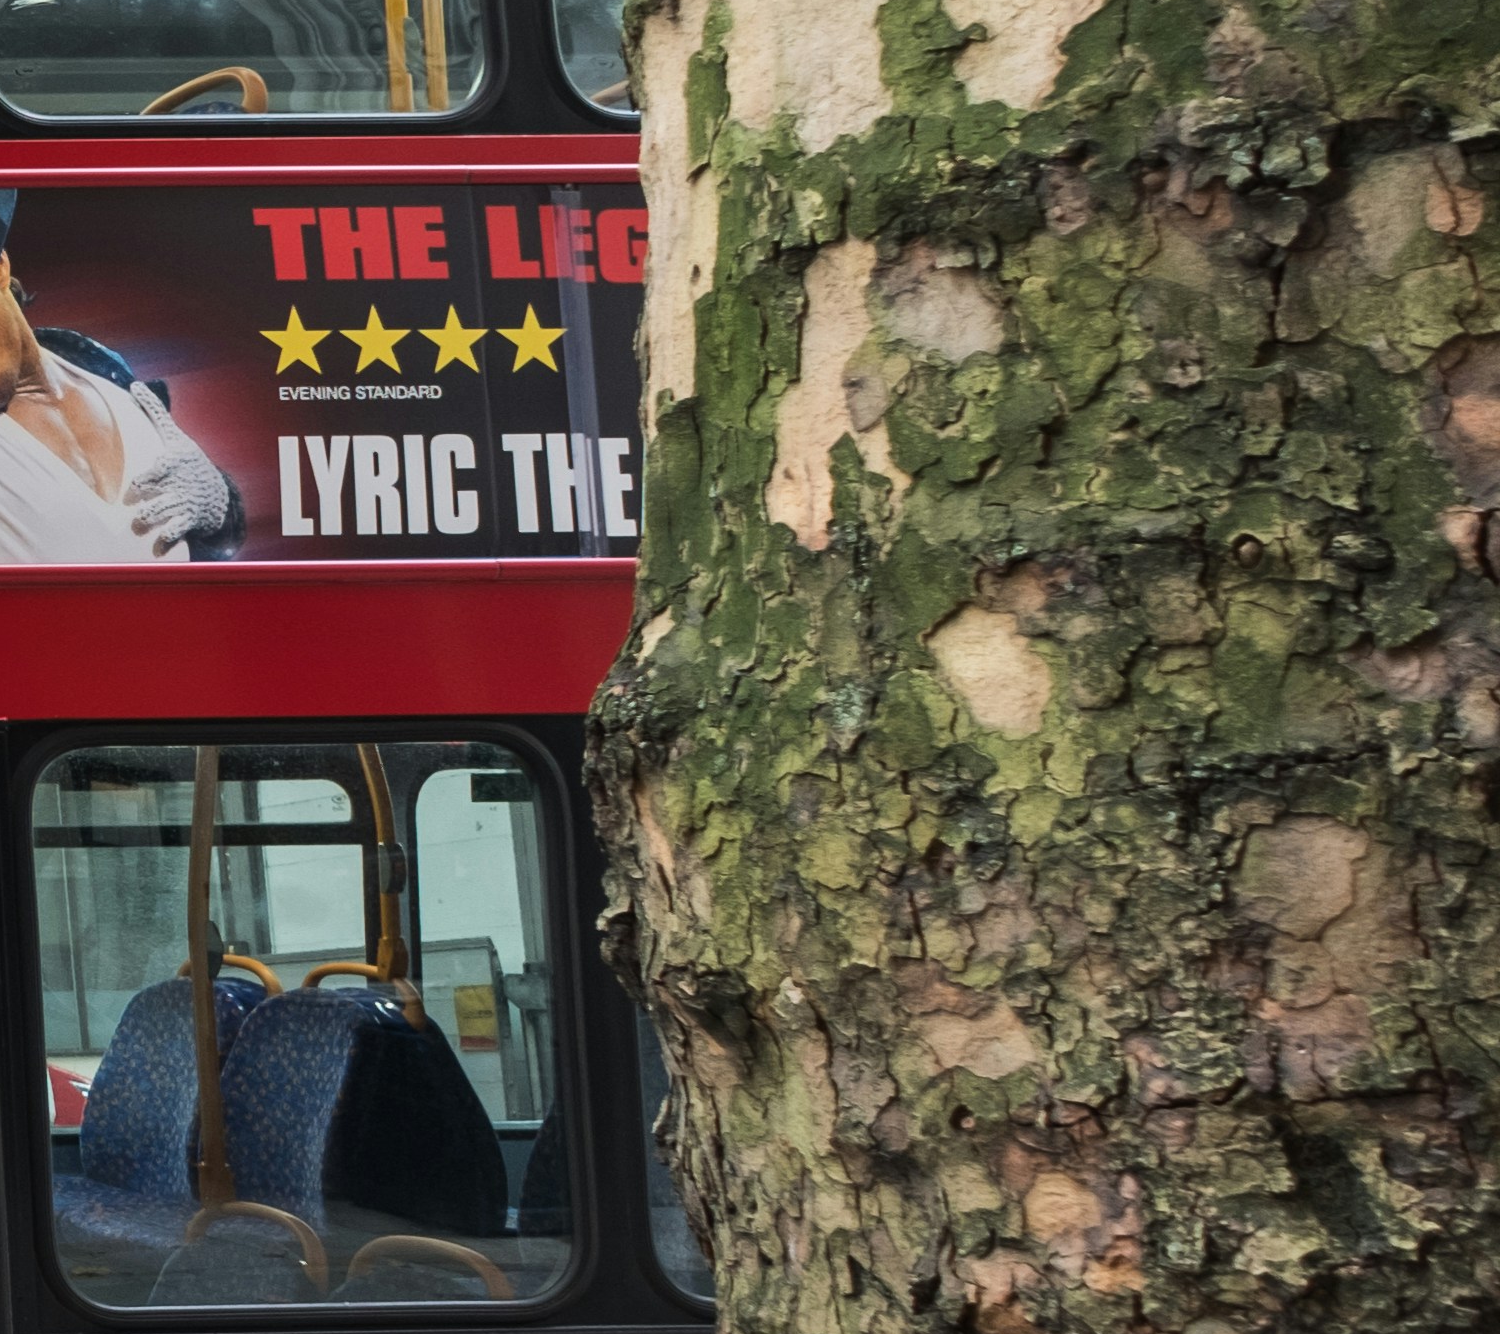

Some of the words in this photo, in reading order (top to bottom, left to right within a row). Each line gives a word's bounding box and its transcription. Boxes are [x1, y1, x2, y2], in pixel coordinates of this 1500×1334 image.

[252, 205, 450, 282] THE
[278, 385, 351, 402] EVENING
[354, 384, 443, 401] STANDARD
[277, 434, 481, 537] LYRIC
[501, 432, 638, 538] THE
